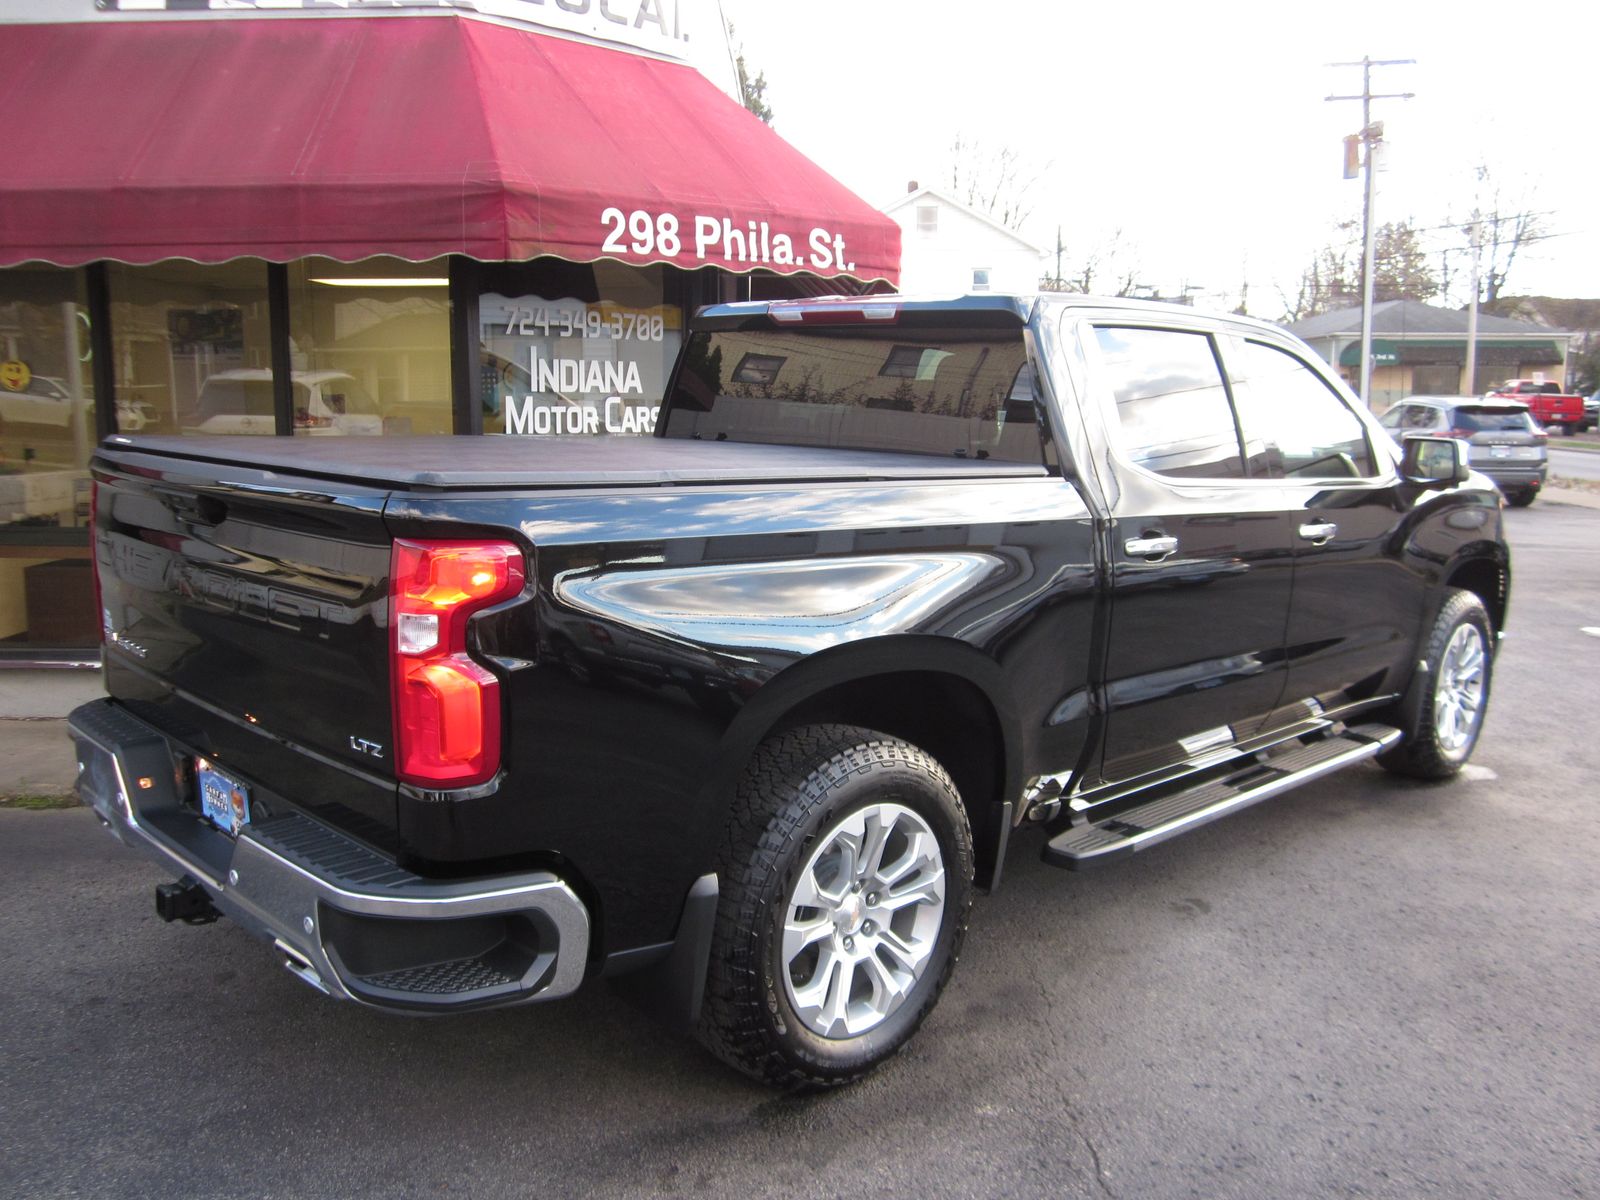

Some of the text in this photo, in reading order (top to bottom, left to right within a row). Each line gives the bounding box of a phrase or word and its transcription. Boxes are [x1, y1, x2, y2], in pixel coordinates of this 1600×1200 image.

[601, 207, 856, 272] 298 Phila. St.
[503, 305, 664, 342] 724-349-3700
[530, 345, 643, 394] INDIANA
[505, 395, 600, 435] MOTOR
[350, 735, 384, 758] LTZ
